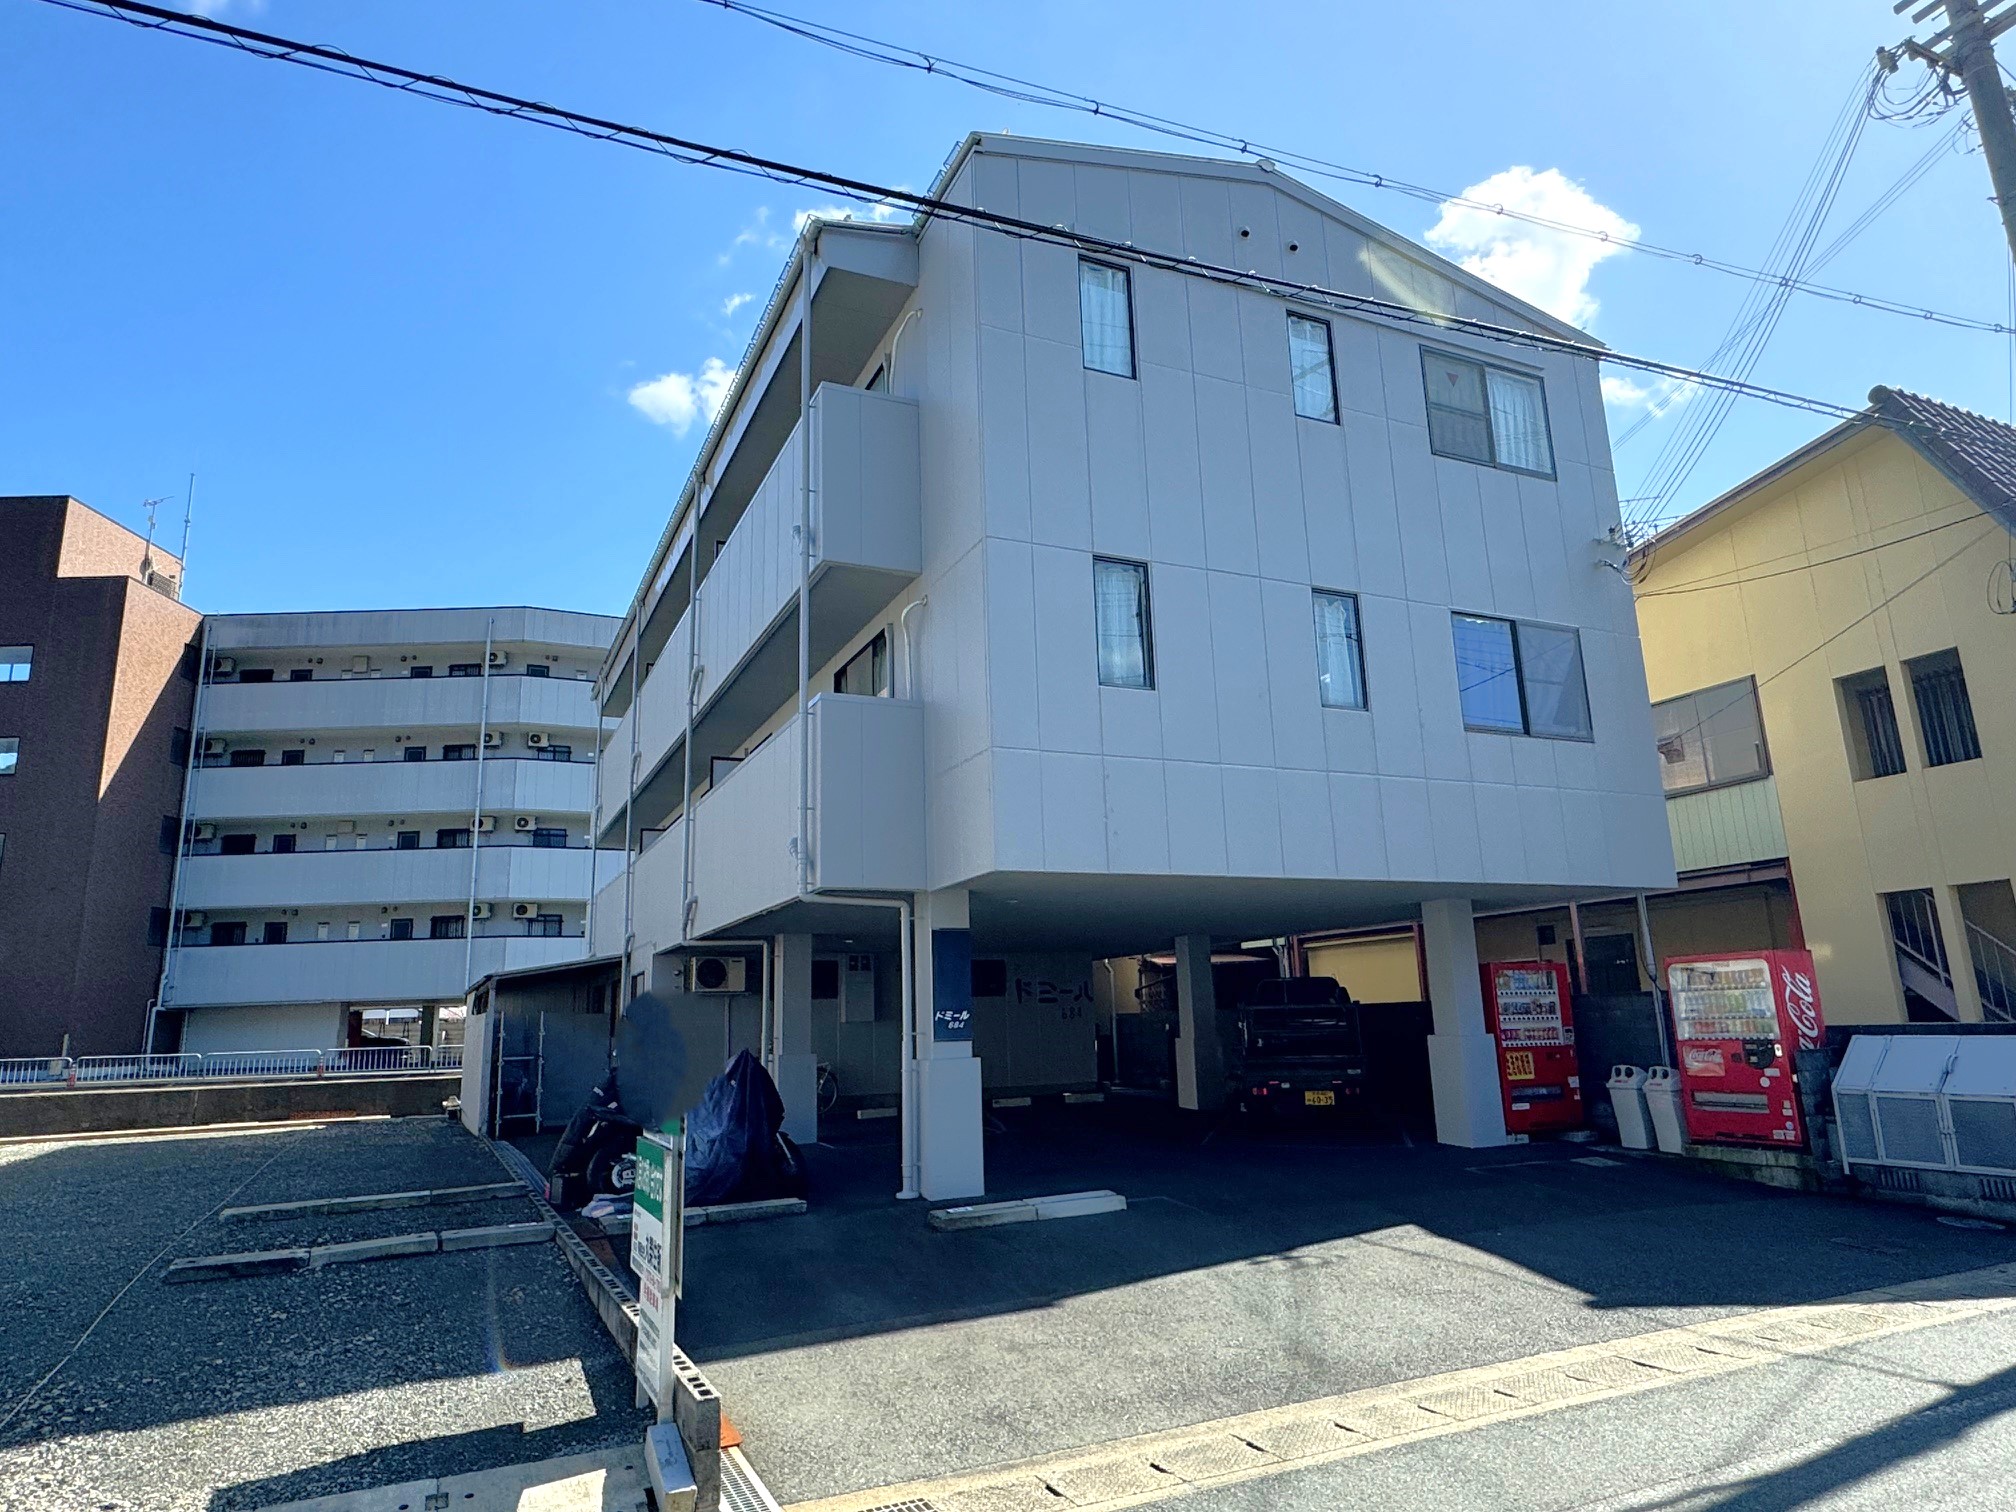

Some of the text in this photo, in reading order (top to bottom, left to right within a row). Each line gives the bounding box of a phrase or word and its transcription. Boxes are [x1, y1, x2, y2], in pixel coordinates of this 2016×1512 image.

[1015, 978, 1094, 1004] ドミール
[935, 1010, 970, 1021] ドミール
[948, 1021, 965, 1029] 684
